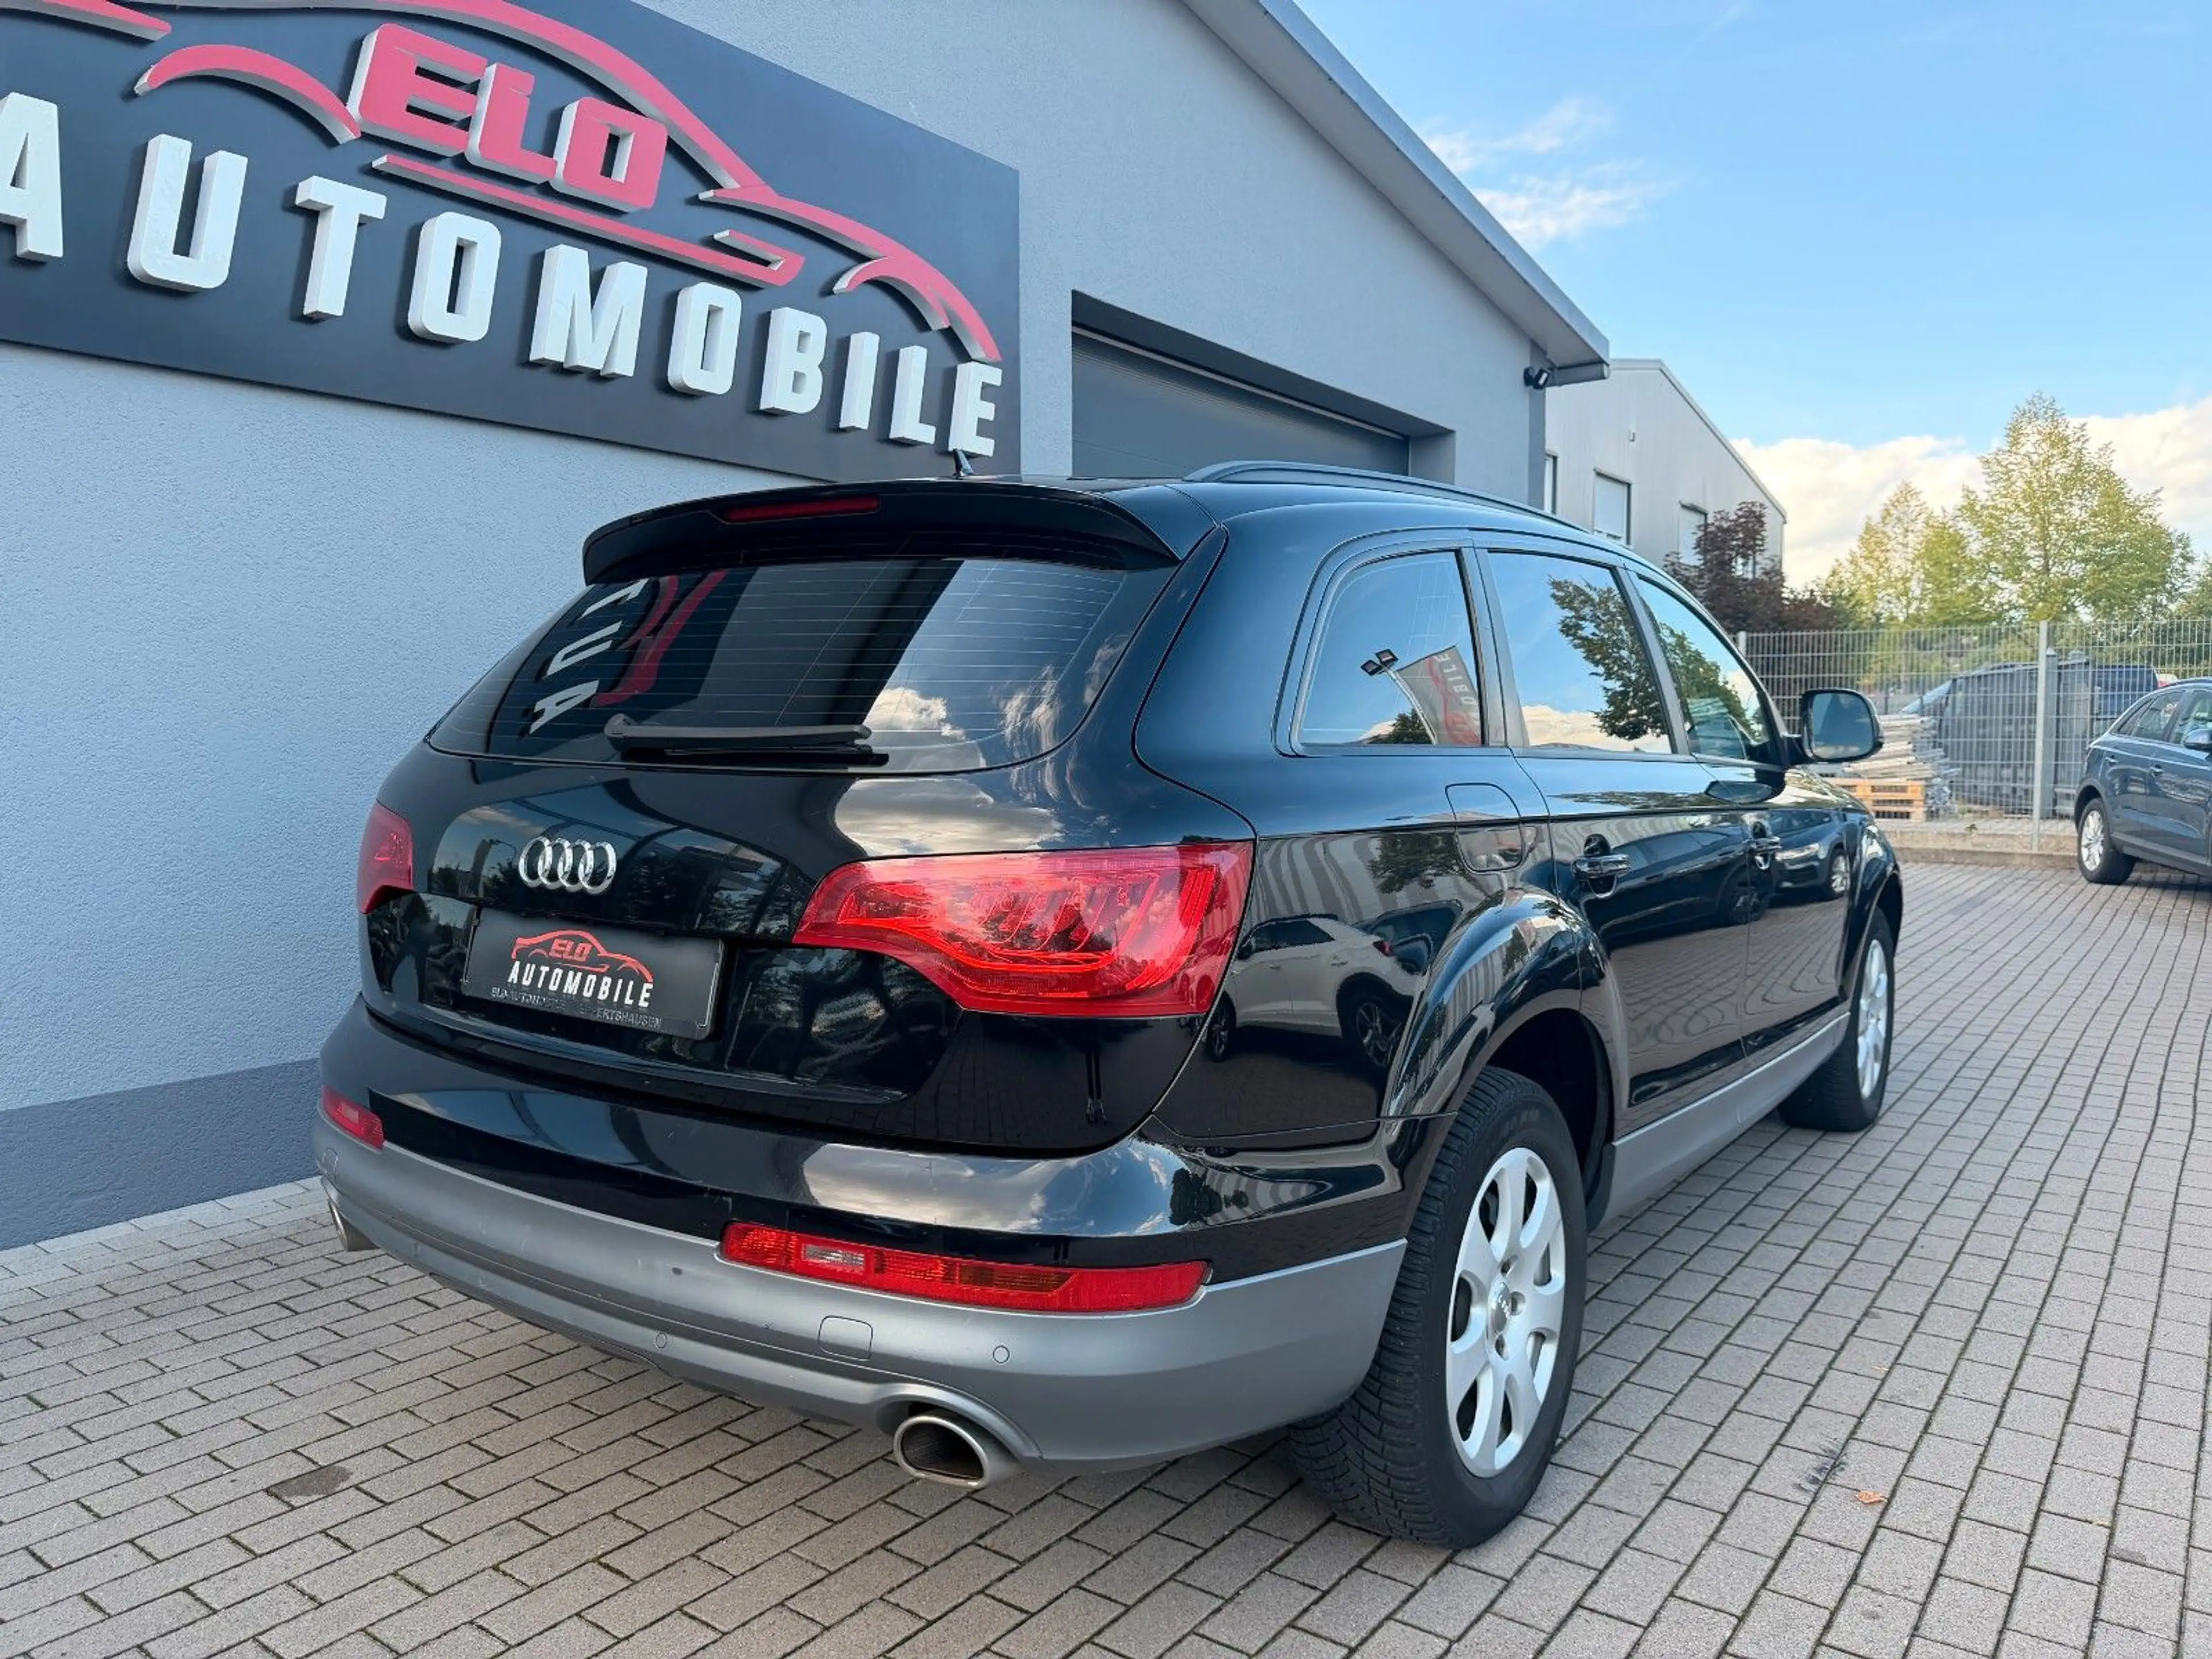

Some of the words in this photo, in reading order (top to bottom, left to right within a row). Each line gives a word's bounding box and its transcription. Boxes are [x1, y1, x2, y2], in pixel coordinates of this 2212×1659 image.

[346, 23, 668, 213] ELO
[0, 92, 1003, 457] AUTOMOBILE
[507, 960, 654, 1008] AUTOMOBILE
[549, 939, 593, 962] ELO
